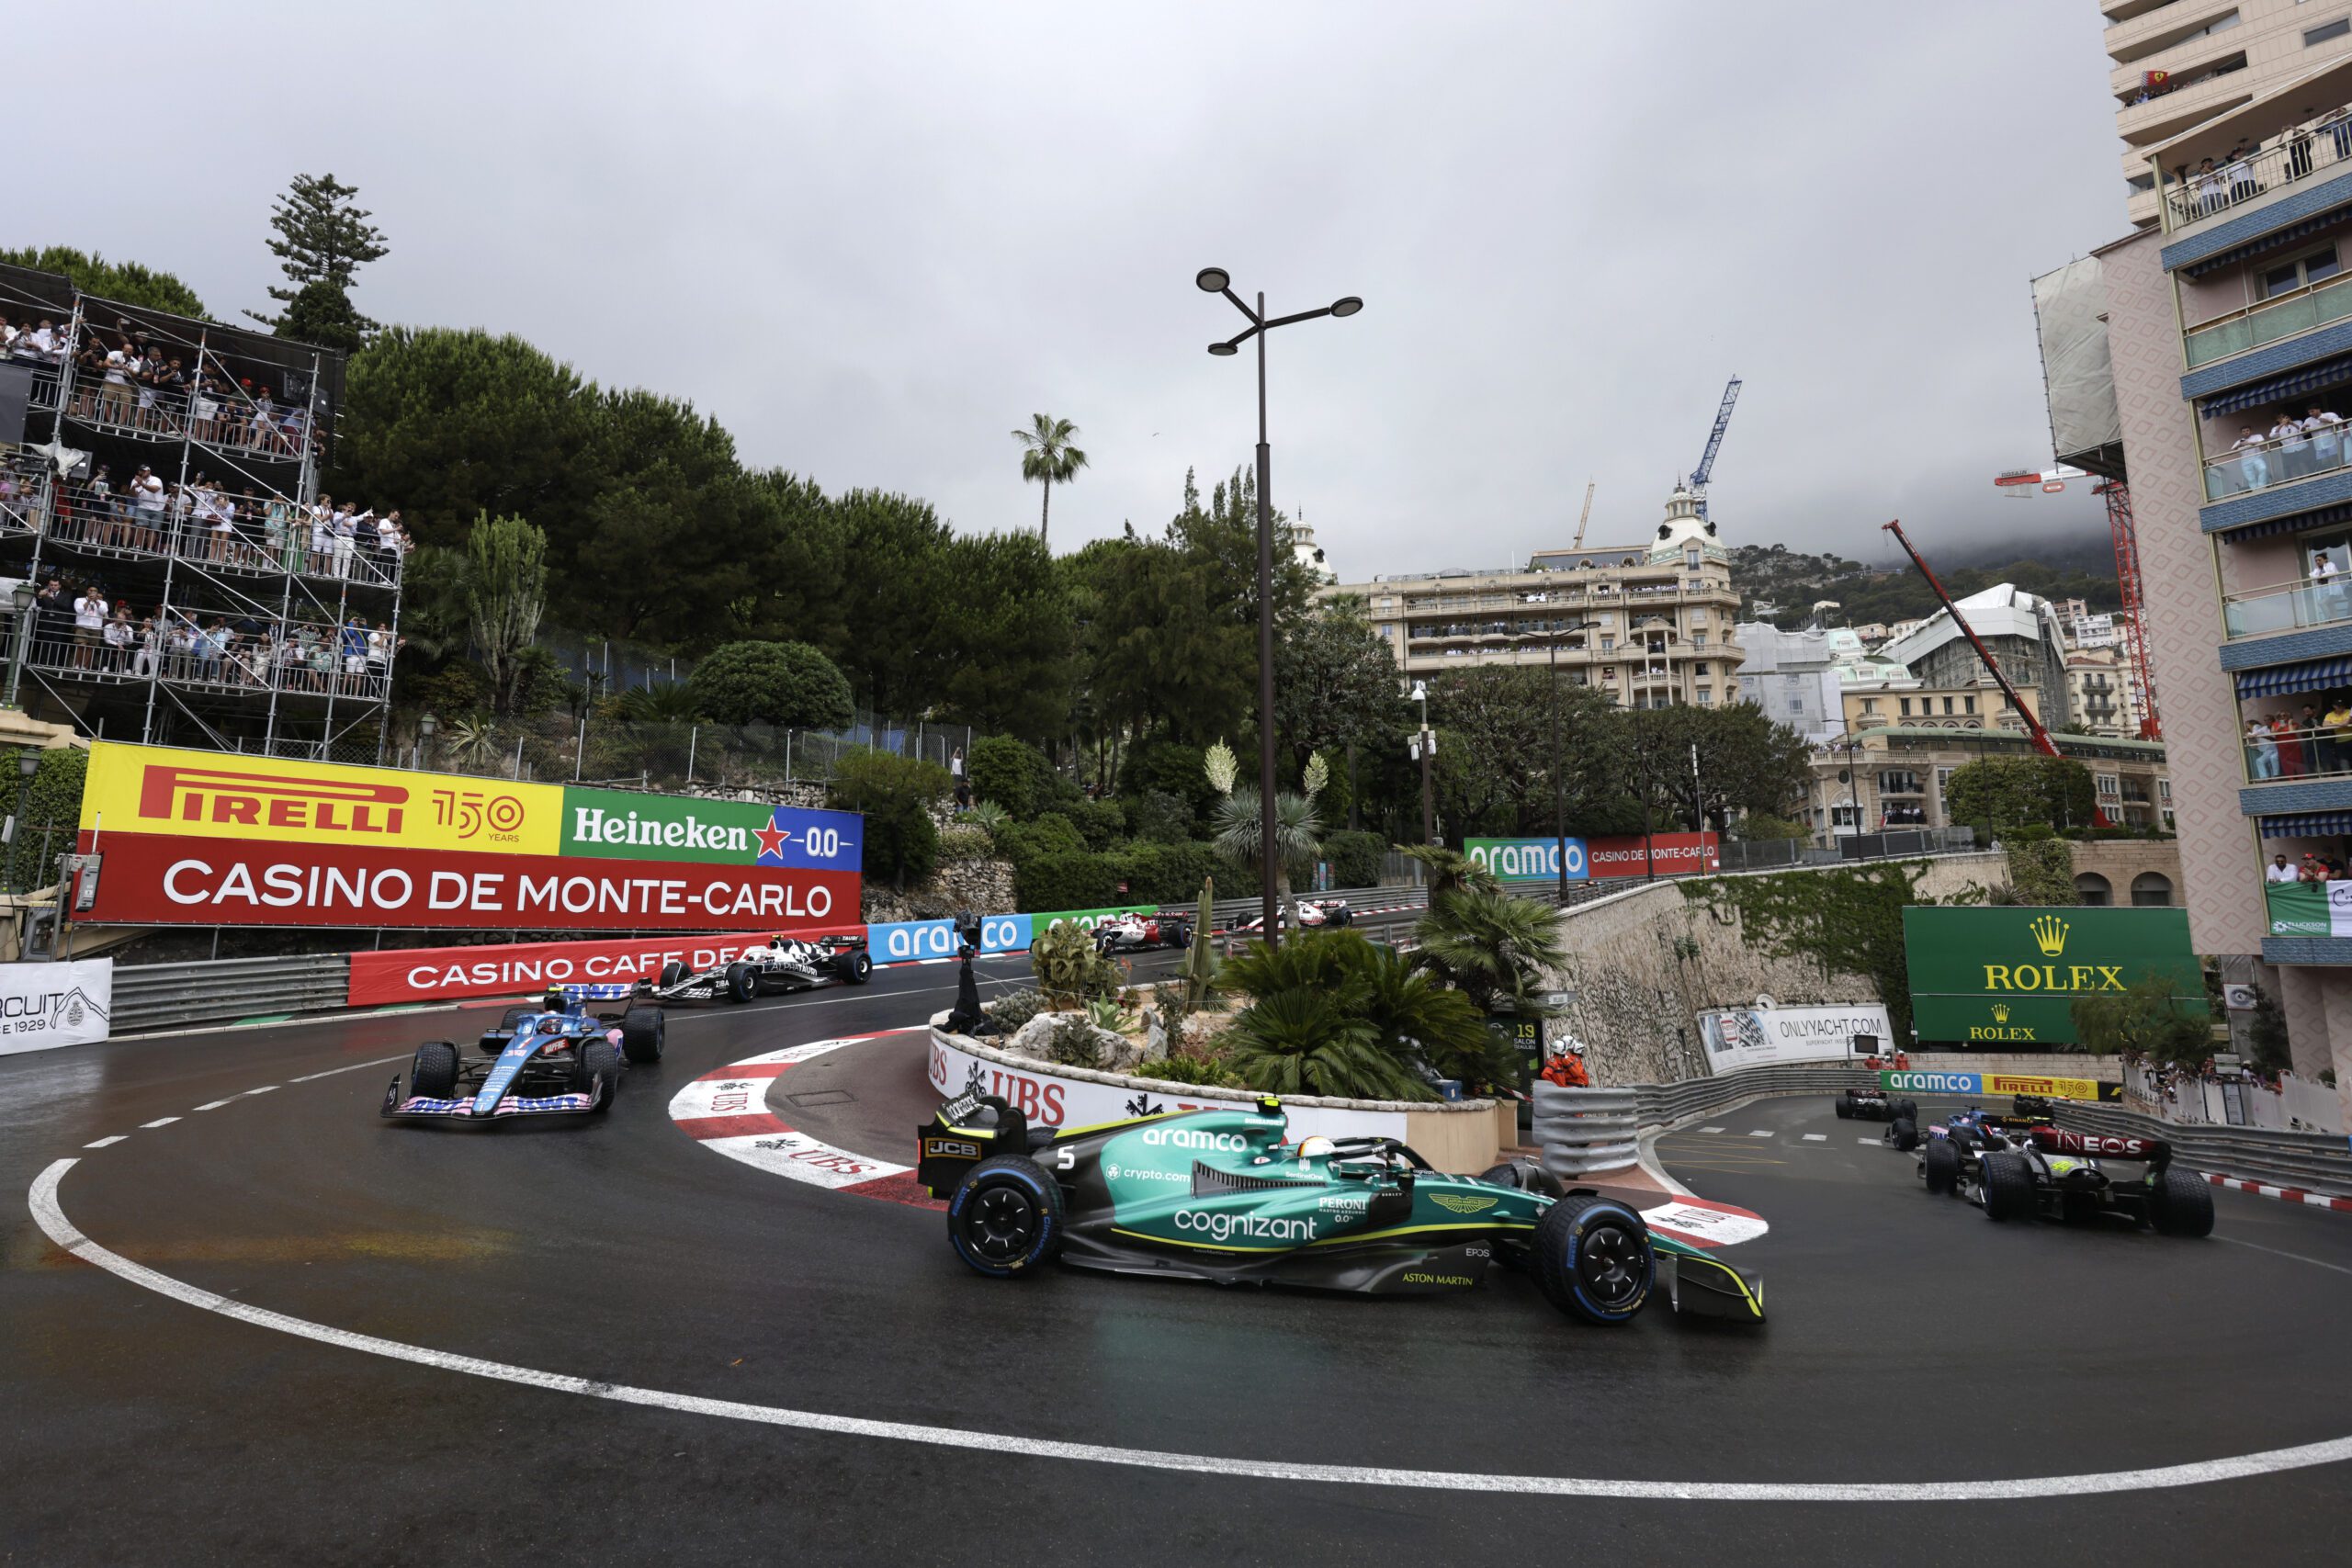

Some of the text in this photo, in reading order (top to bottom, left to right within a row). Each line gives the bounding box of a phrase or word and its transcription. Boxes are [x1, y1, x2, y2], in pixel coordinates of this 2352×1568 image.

[138, 764, 410, 834] PIRELLI
[433, 789, 525, 839] 150
[488, 833, 520, 843] YEARS
[572, 807, 748, 852] Heineken
[1592, 850, 1630, 863] CASINO
[1631, 849, 1645, 861] DE
[163, 859, 832, 918] CASINO DE MONTE-CARLO
[888, 920, 1018, 957] araco
[407, 947, 739, 988] CASINO CAFE DE
[715, 979, 729, 988] ZIBA
[1983, 964, 2128, 991] ROLEX
[562, 985, 626, 998] BWT
[14, 1019, 46, 1032] 1929
[1780, 1018, 1883, 1038] ONLYYACHT.COM
[1969, 1027, 2036, 1041] ROLEX
[929, 1042, 947, 1086] UBS
[1890, 1073, 1972, 1091] aramco
[1993, 1077, 2053, 1094] PIRELLI
[710, 1092, 749, 1111] UBS
[992, 1069, 1066, 1127] UBS
[1244, 1117, 1284, 1126] BOMBARDIER
[930, 1141, 978, 1156] JCB
[1143, 1128, 1248, 1153] aramco
[2056, 1134, 2143, 1155] INEOS
[788, 1148, 878, 1175] UBS
[1057, 1145, 1076, 1170] 5
[1124, 1168, 1191, 1183] crypto.com
[1285, 1171, 1324, 1180] SentinelOne
[1319, 1197, 1366, 1210] PERONI
[1174, 1209, 1317, 1241] cognizant
[1465, 1247, 1490, 1258] EPOS
[1402, 1272, 1474, 1286] ASTON MARTIN
